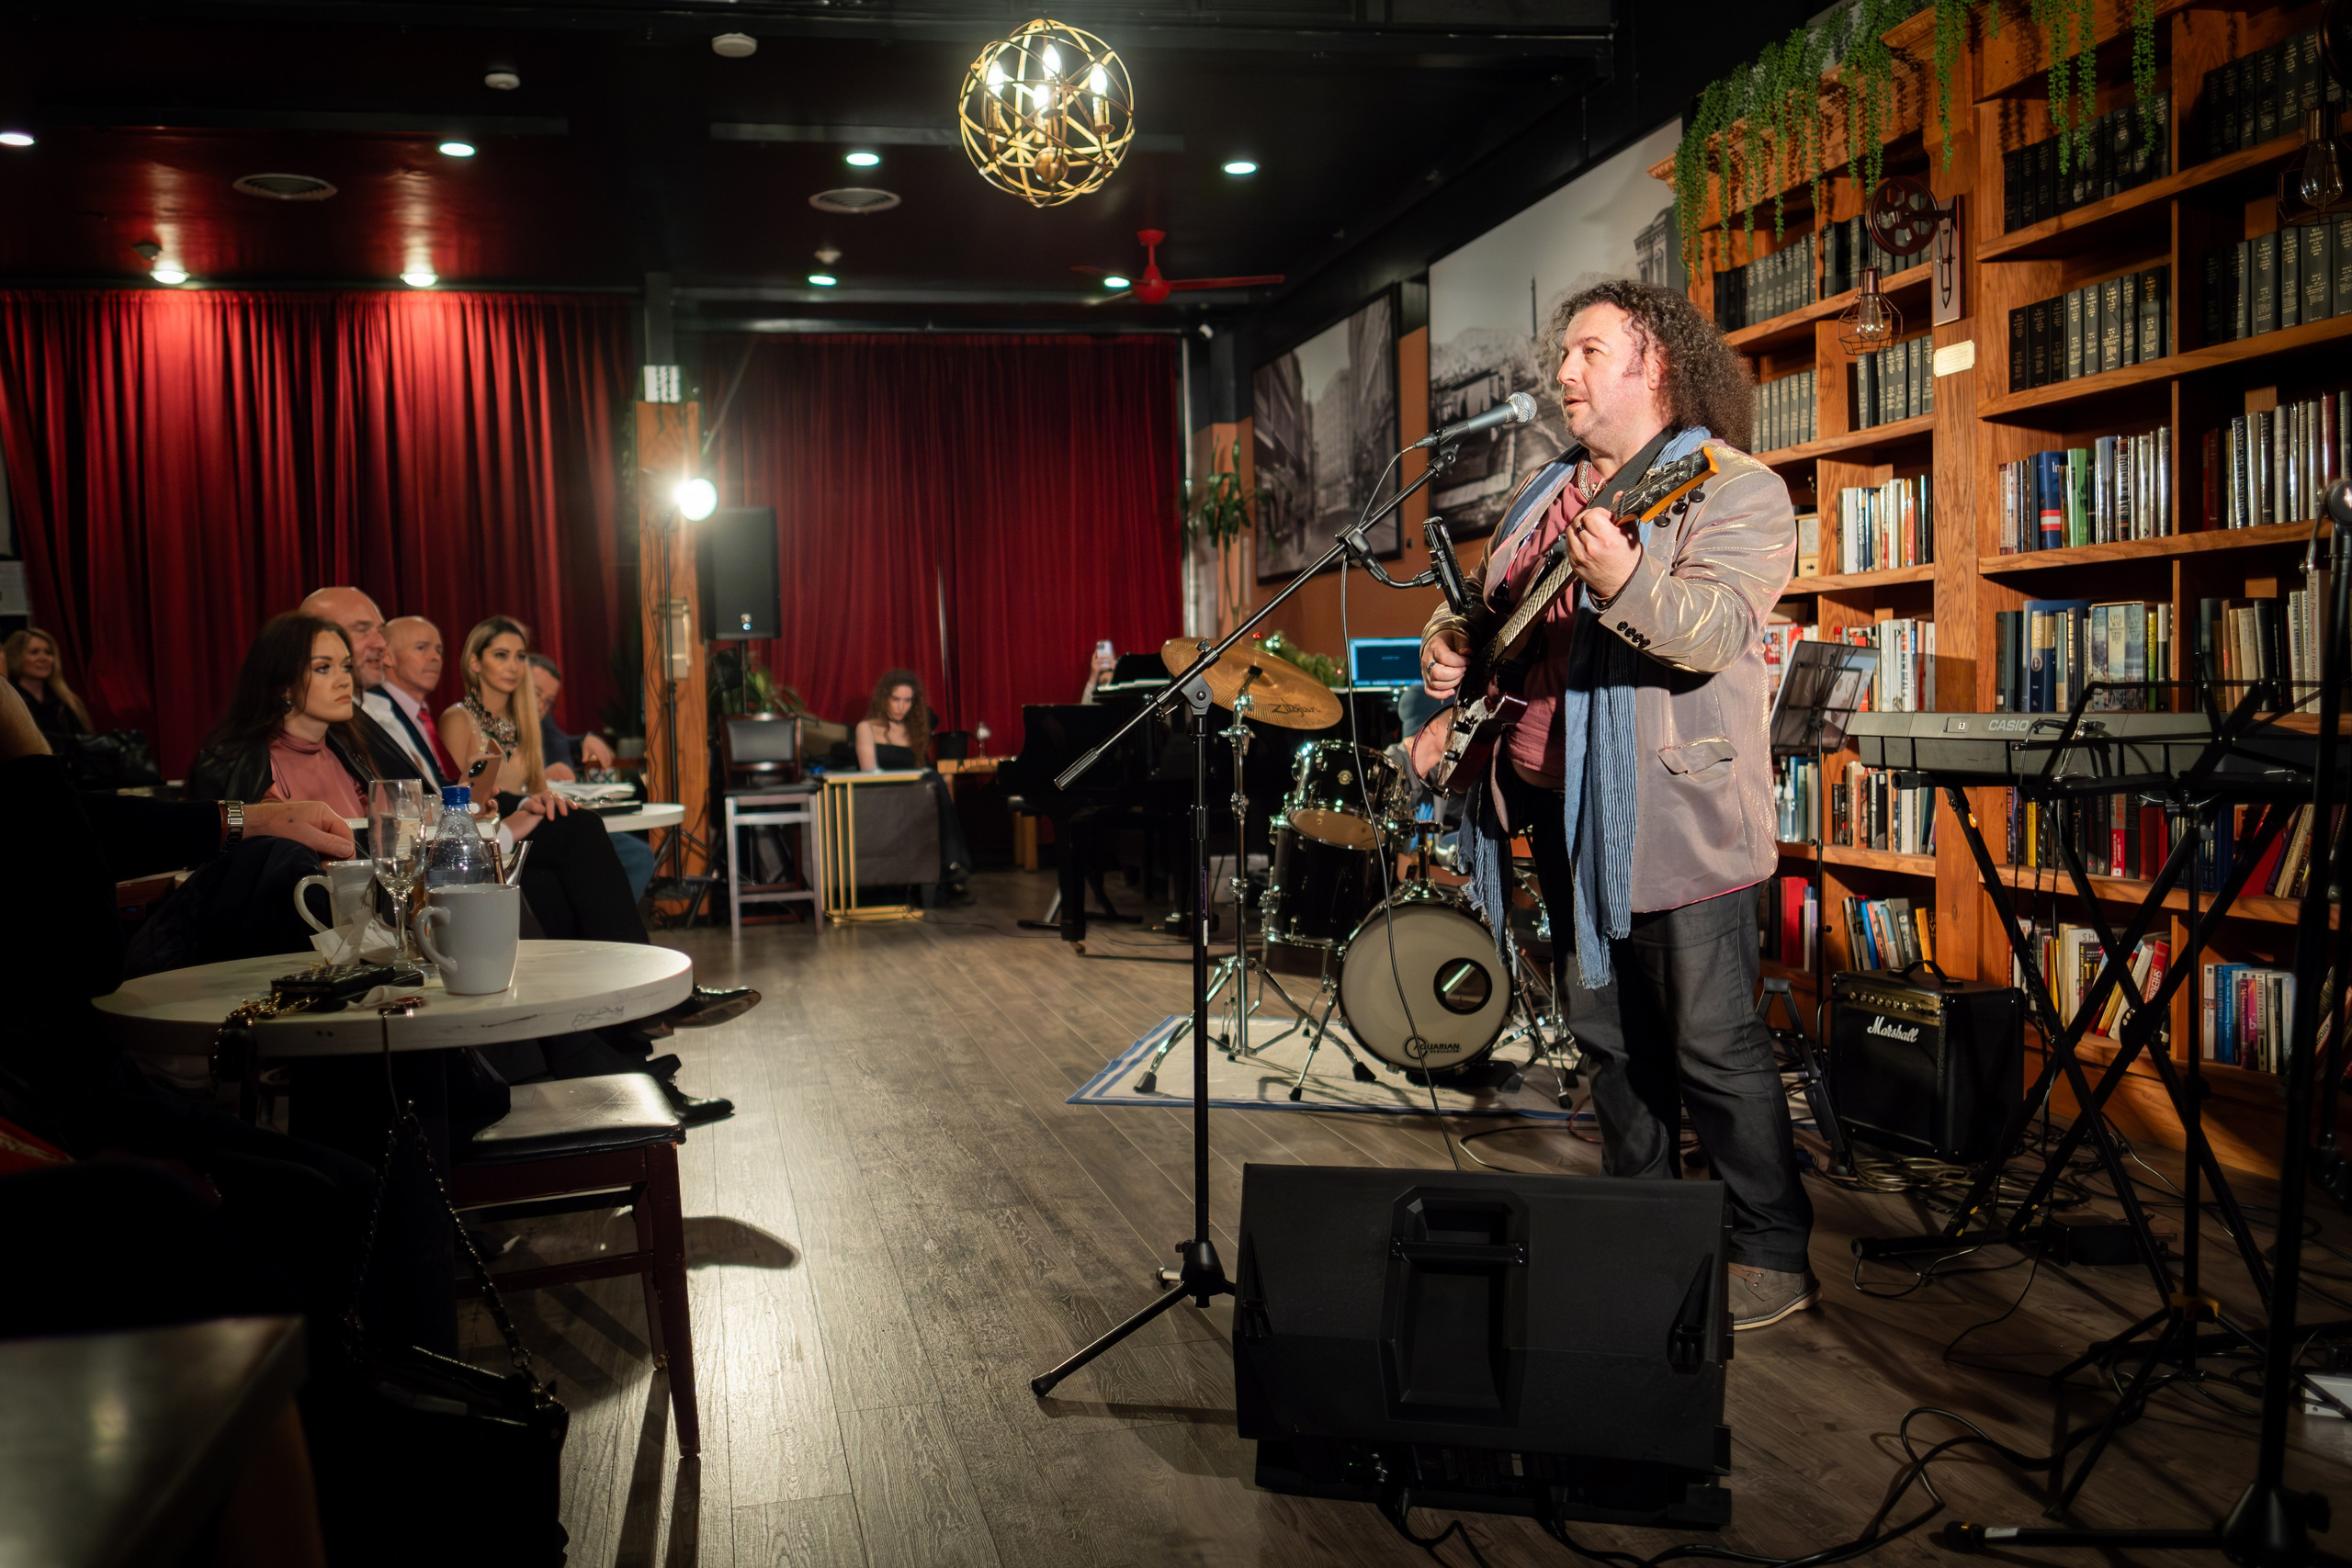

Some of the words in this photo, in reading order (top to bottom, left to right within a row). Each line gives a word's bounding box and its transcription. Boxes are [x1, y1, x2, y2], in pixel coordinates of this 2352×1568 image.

[2116, 453, 2129, 489] ROBERT
[2309, 581, 2317, 600] Early
[2309, 602, 2317, 646] Photography
[1988, 719, 2030, 732] CASIO
[2082, 932, 2098, 942] SH
[1866, 1015, 1919, 1043] Marshall
